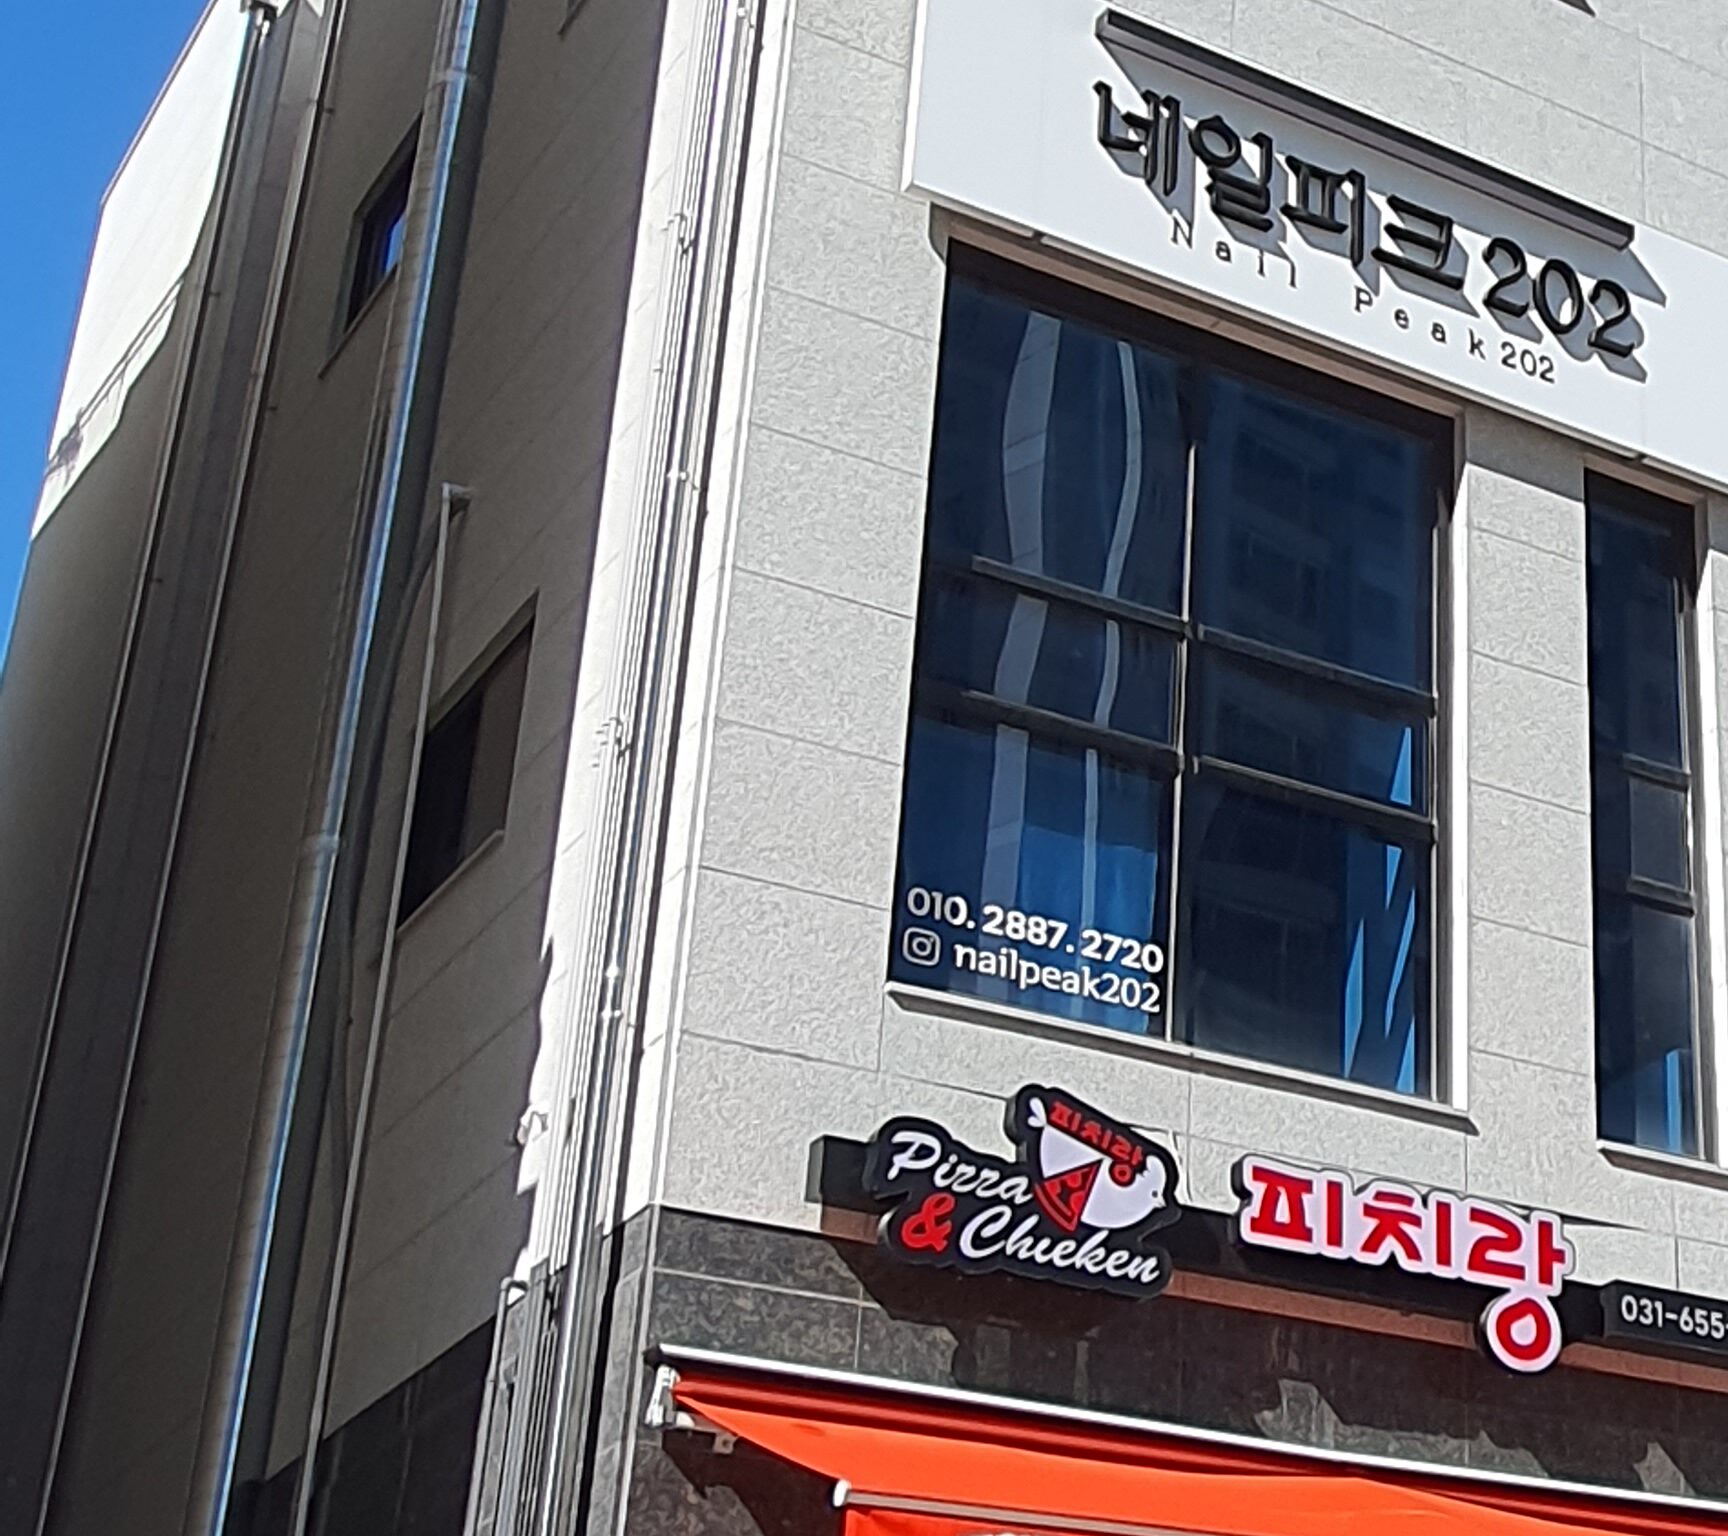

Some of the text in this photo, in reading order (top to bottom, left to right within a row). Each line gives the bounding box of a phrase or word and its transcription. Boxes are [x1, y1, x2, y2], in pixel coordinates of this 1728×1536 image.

[1092, 80, 1636, 357] 네일피크202
[1170, 208, 1299, 289] Nail
[954, 940, 1162, 1014] nailpeak202
[886, 1129, 1034, 1204] Pizza
[1050, 1100, 1143, 1183] 피치랑
[901, 1193, 1162, 1285] & Chicken
[1249, 1164, 1567, 1361] 피치랑
